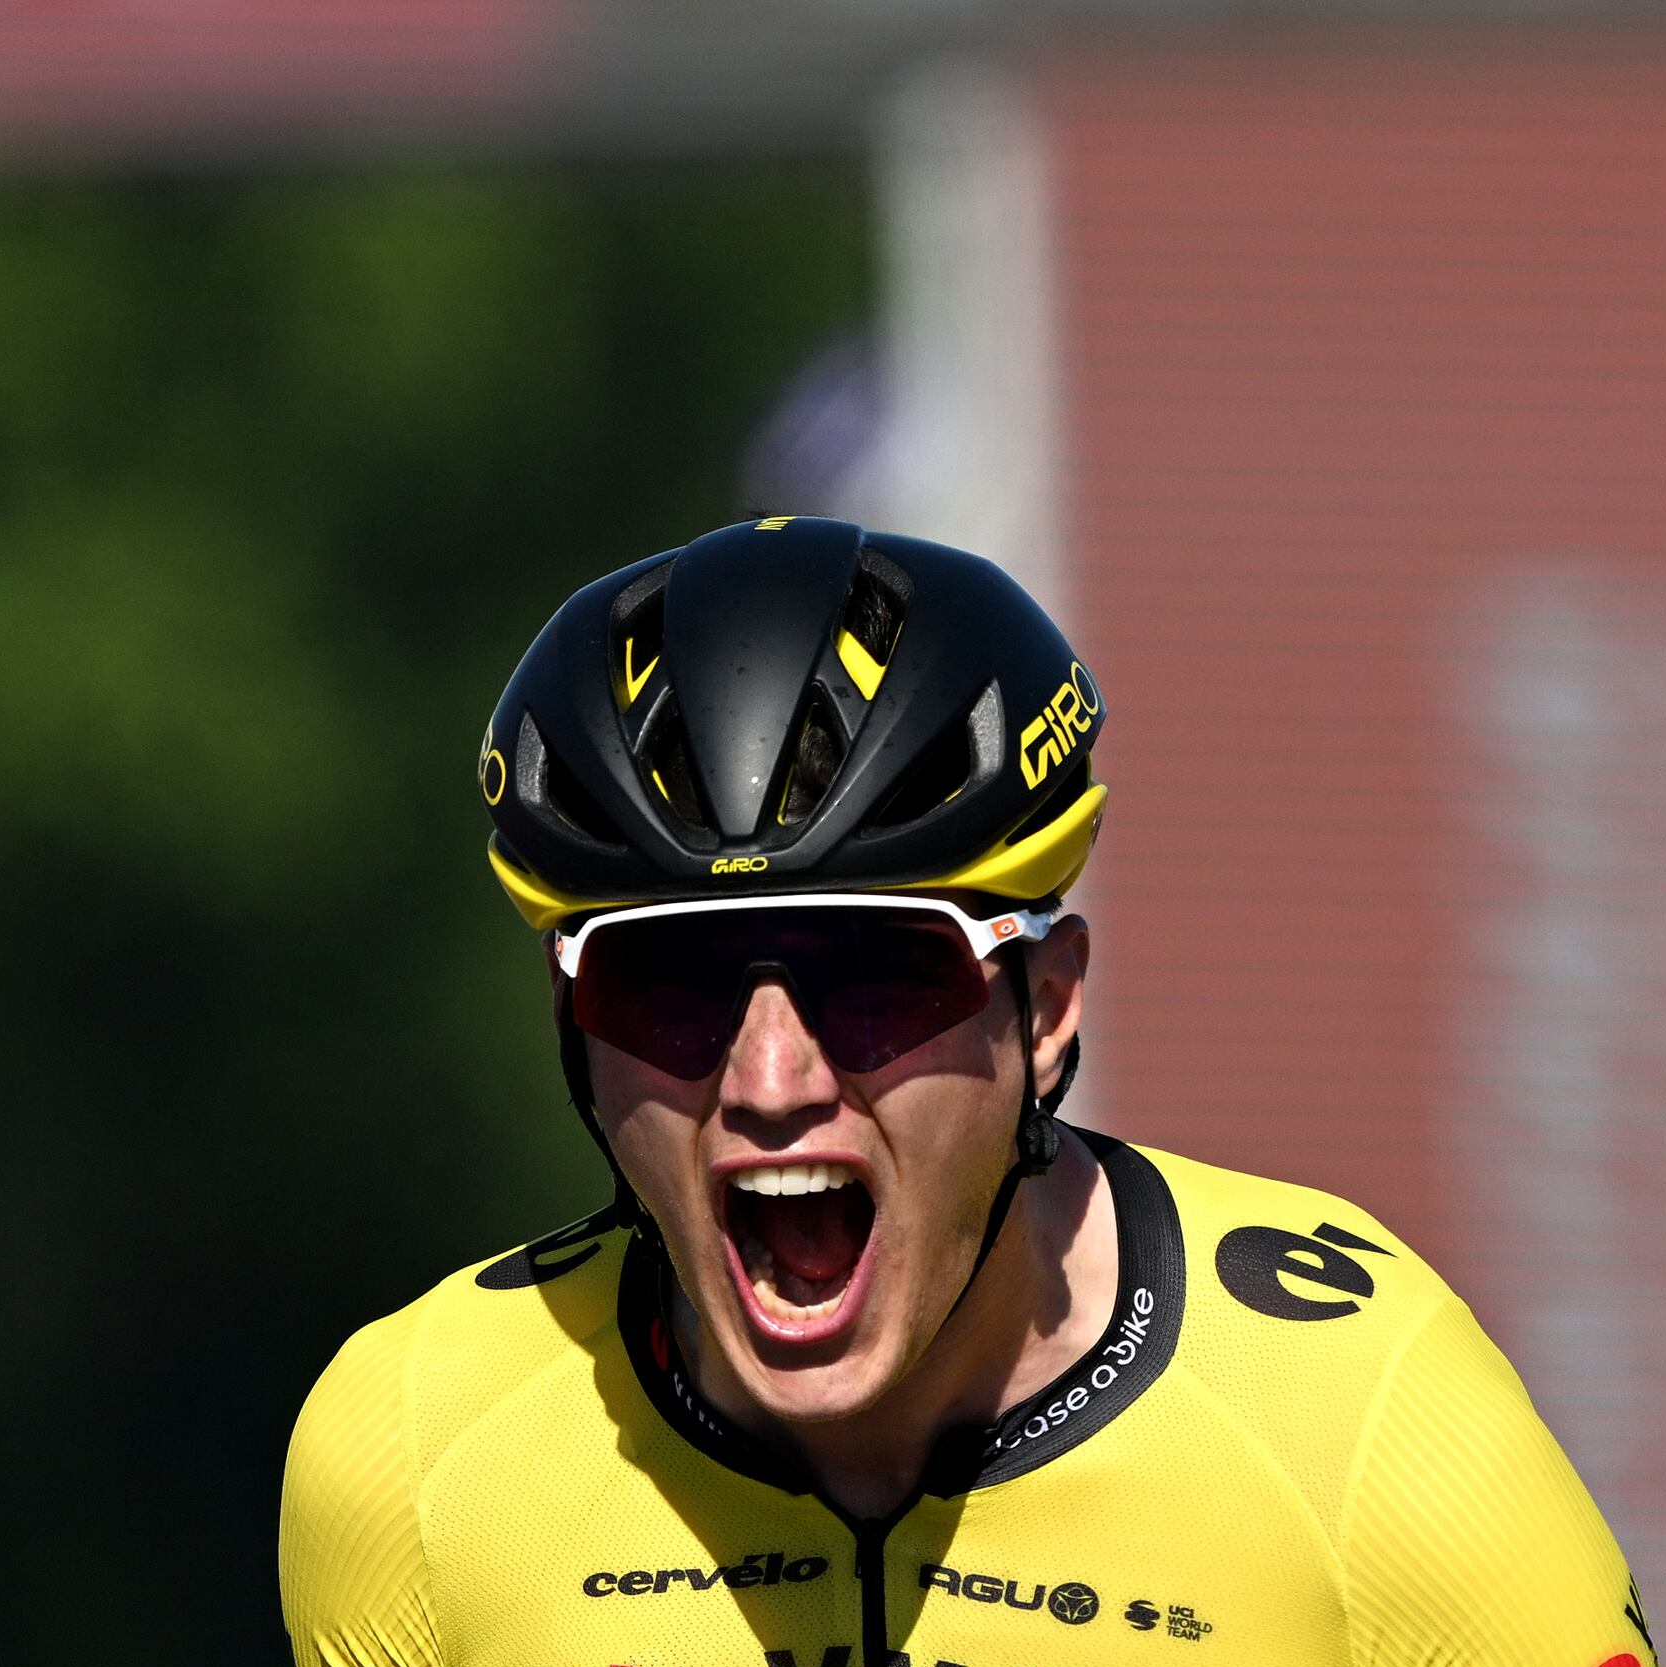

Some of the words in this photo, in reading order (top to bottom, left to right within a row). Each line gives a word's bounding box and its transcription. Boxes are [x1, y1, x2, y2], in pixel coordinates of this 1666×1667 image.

[1020, 661, 1099, 790] GIRO
[711, 856, 769, 875] GIRO
[1103, 1287, 1154, 1366] bike
[1091, 1364, 1119, 1389] a
[996, 1386, 1091, 1449] ase
[582, 1552, 830, 1598] cervélo
[919, 1563, 1047, 1611] AGU
[1167, 1615, 1213, 1634] WORLD
[1168, 1604, 1194, 1618] UCI
[1166, 1625, 1201, 1643] TEAM
